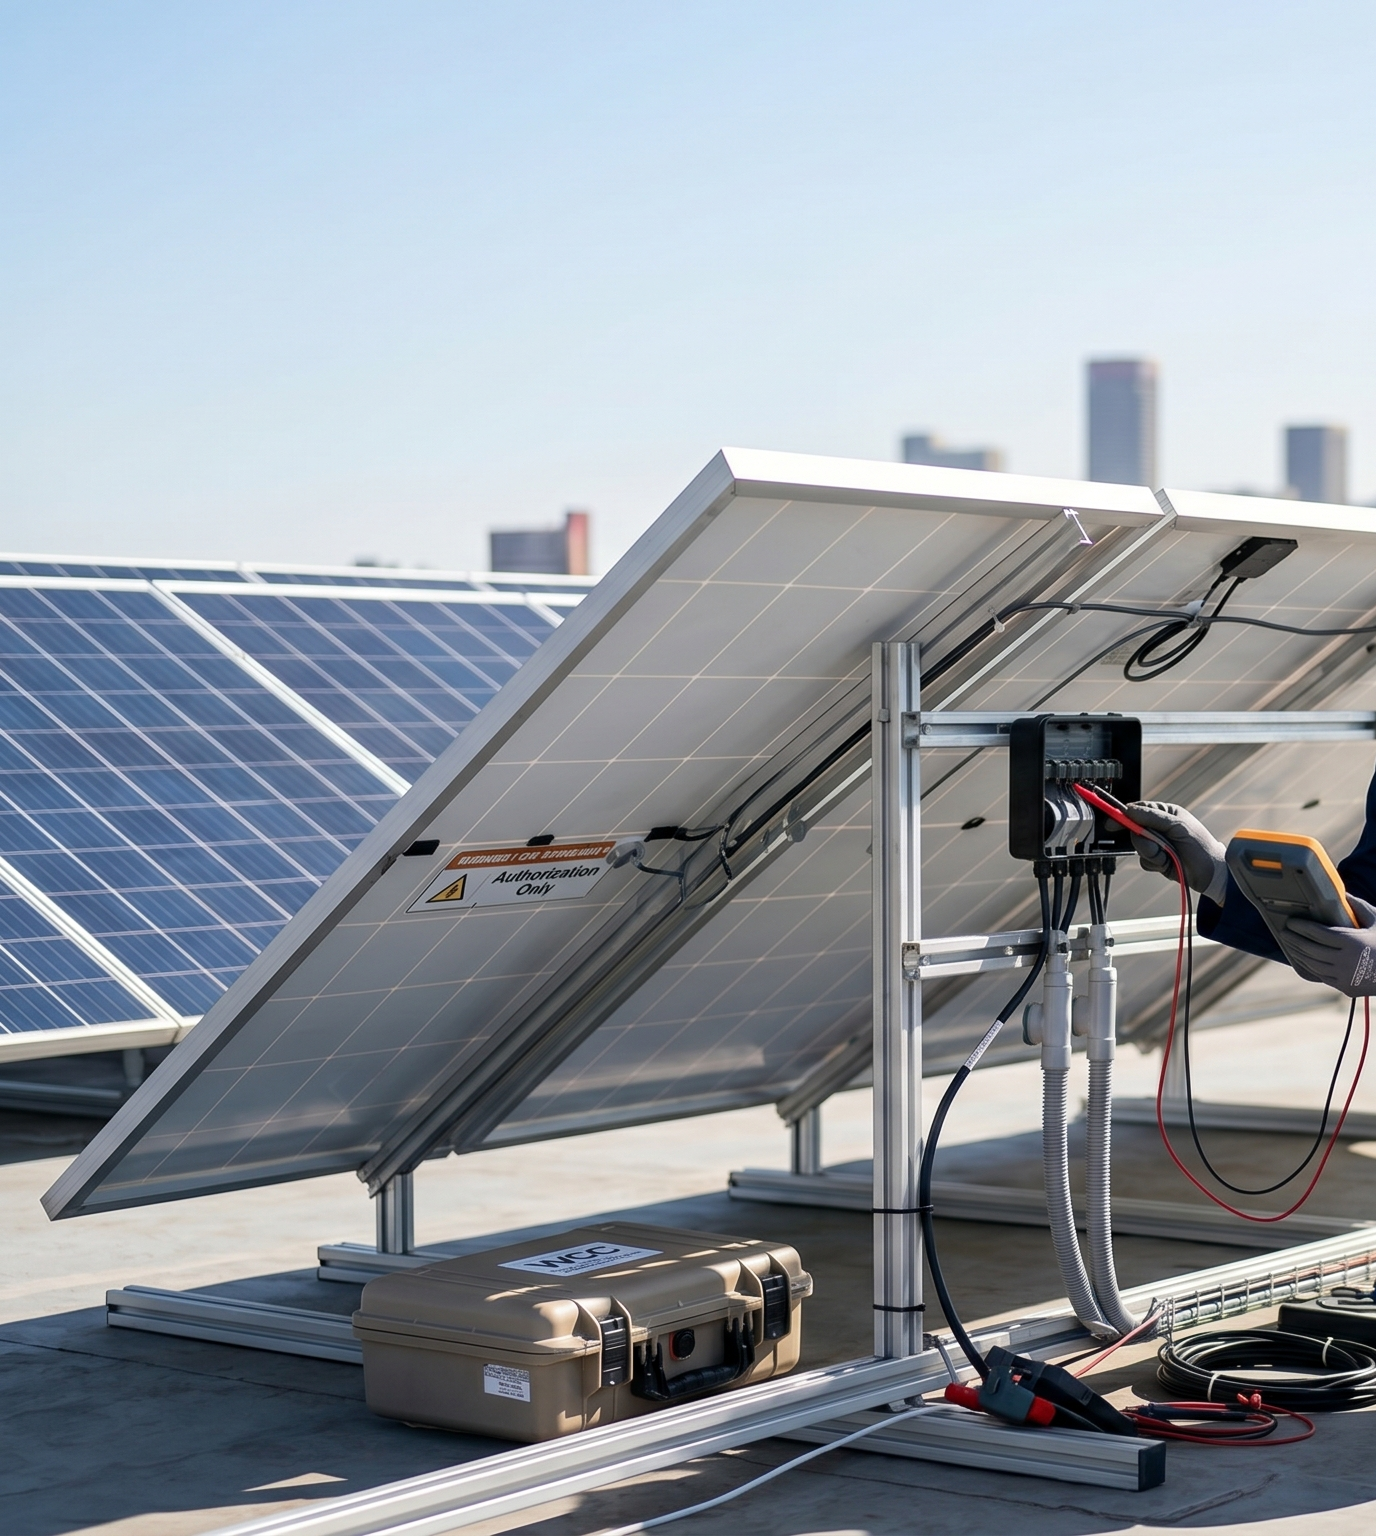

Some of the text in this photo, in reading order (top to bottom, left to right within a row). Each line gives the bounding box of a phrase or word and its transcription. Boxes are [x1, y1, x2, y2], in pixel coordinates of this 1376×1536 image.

[491, 865, 600, 884] Authorization
[516, 883, 556, 897] Only
[524, 1246, 620, 1268] WCC
